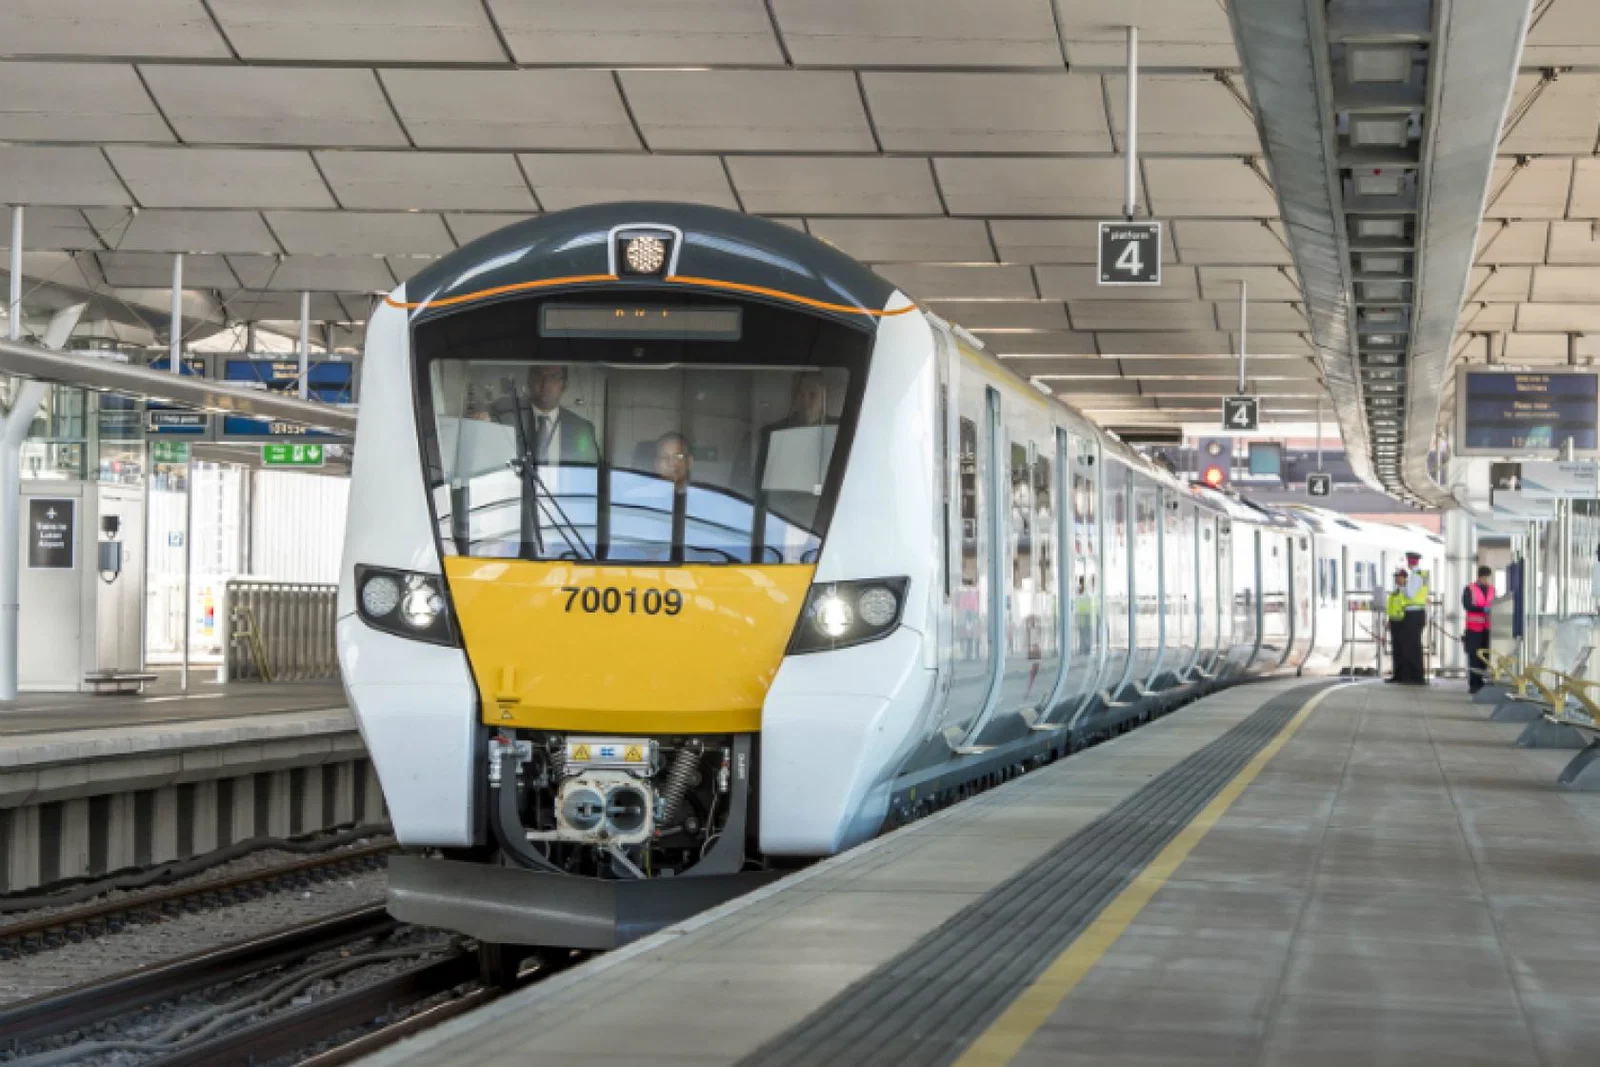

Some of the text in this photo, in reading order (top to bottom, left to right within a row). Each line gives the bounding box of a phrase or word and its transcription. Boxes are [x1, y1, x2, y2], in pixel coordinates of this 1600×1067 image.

[1111, 230, 1150, 241] platform
[1115, 240, 1144, 276] 4
[1232, 403, 1249, 427] 4
[1313, 479, 1326, 494] 4
[561, 586, 683, 615] 700109
